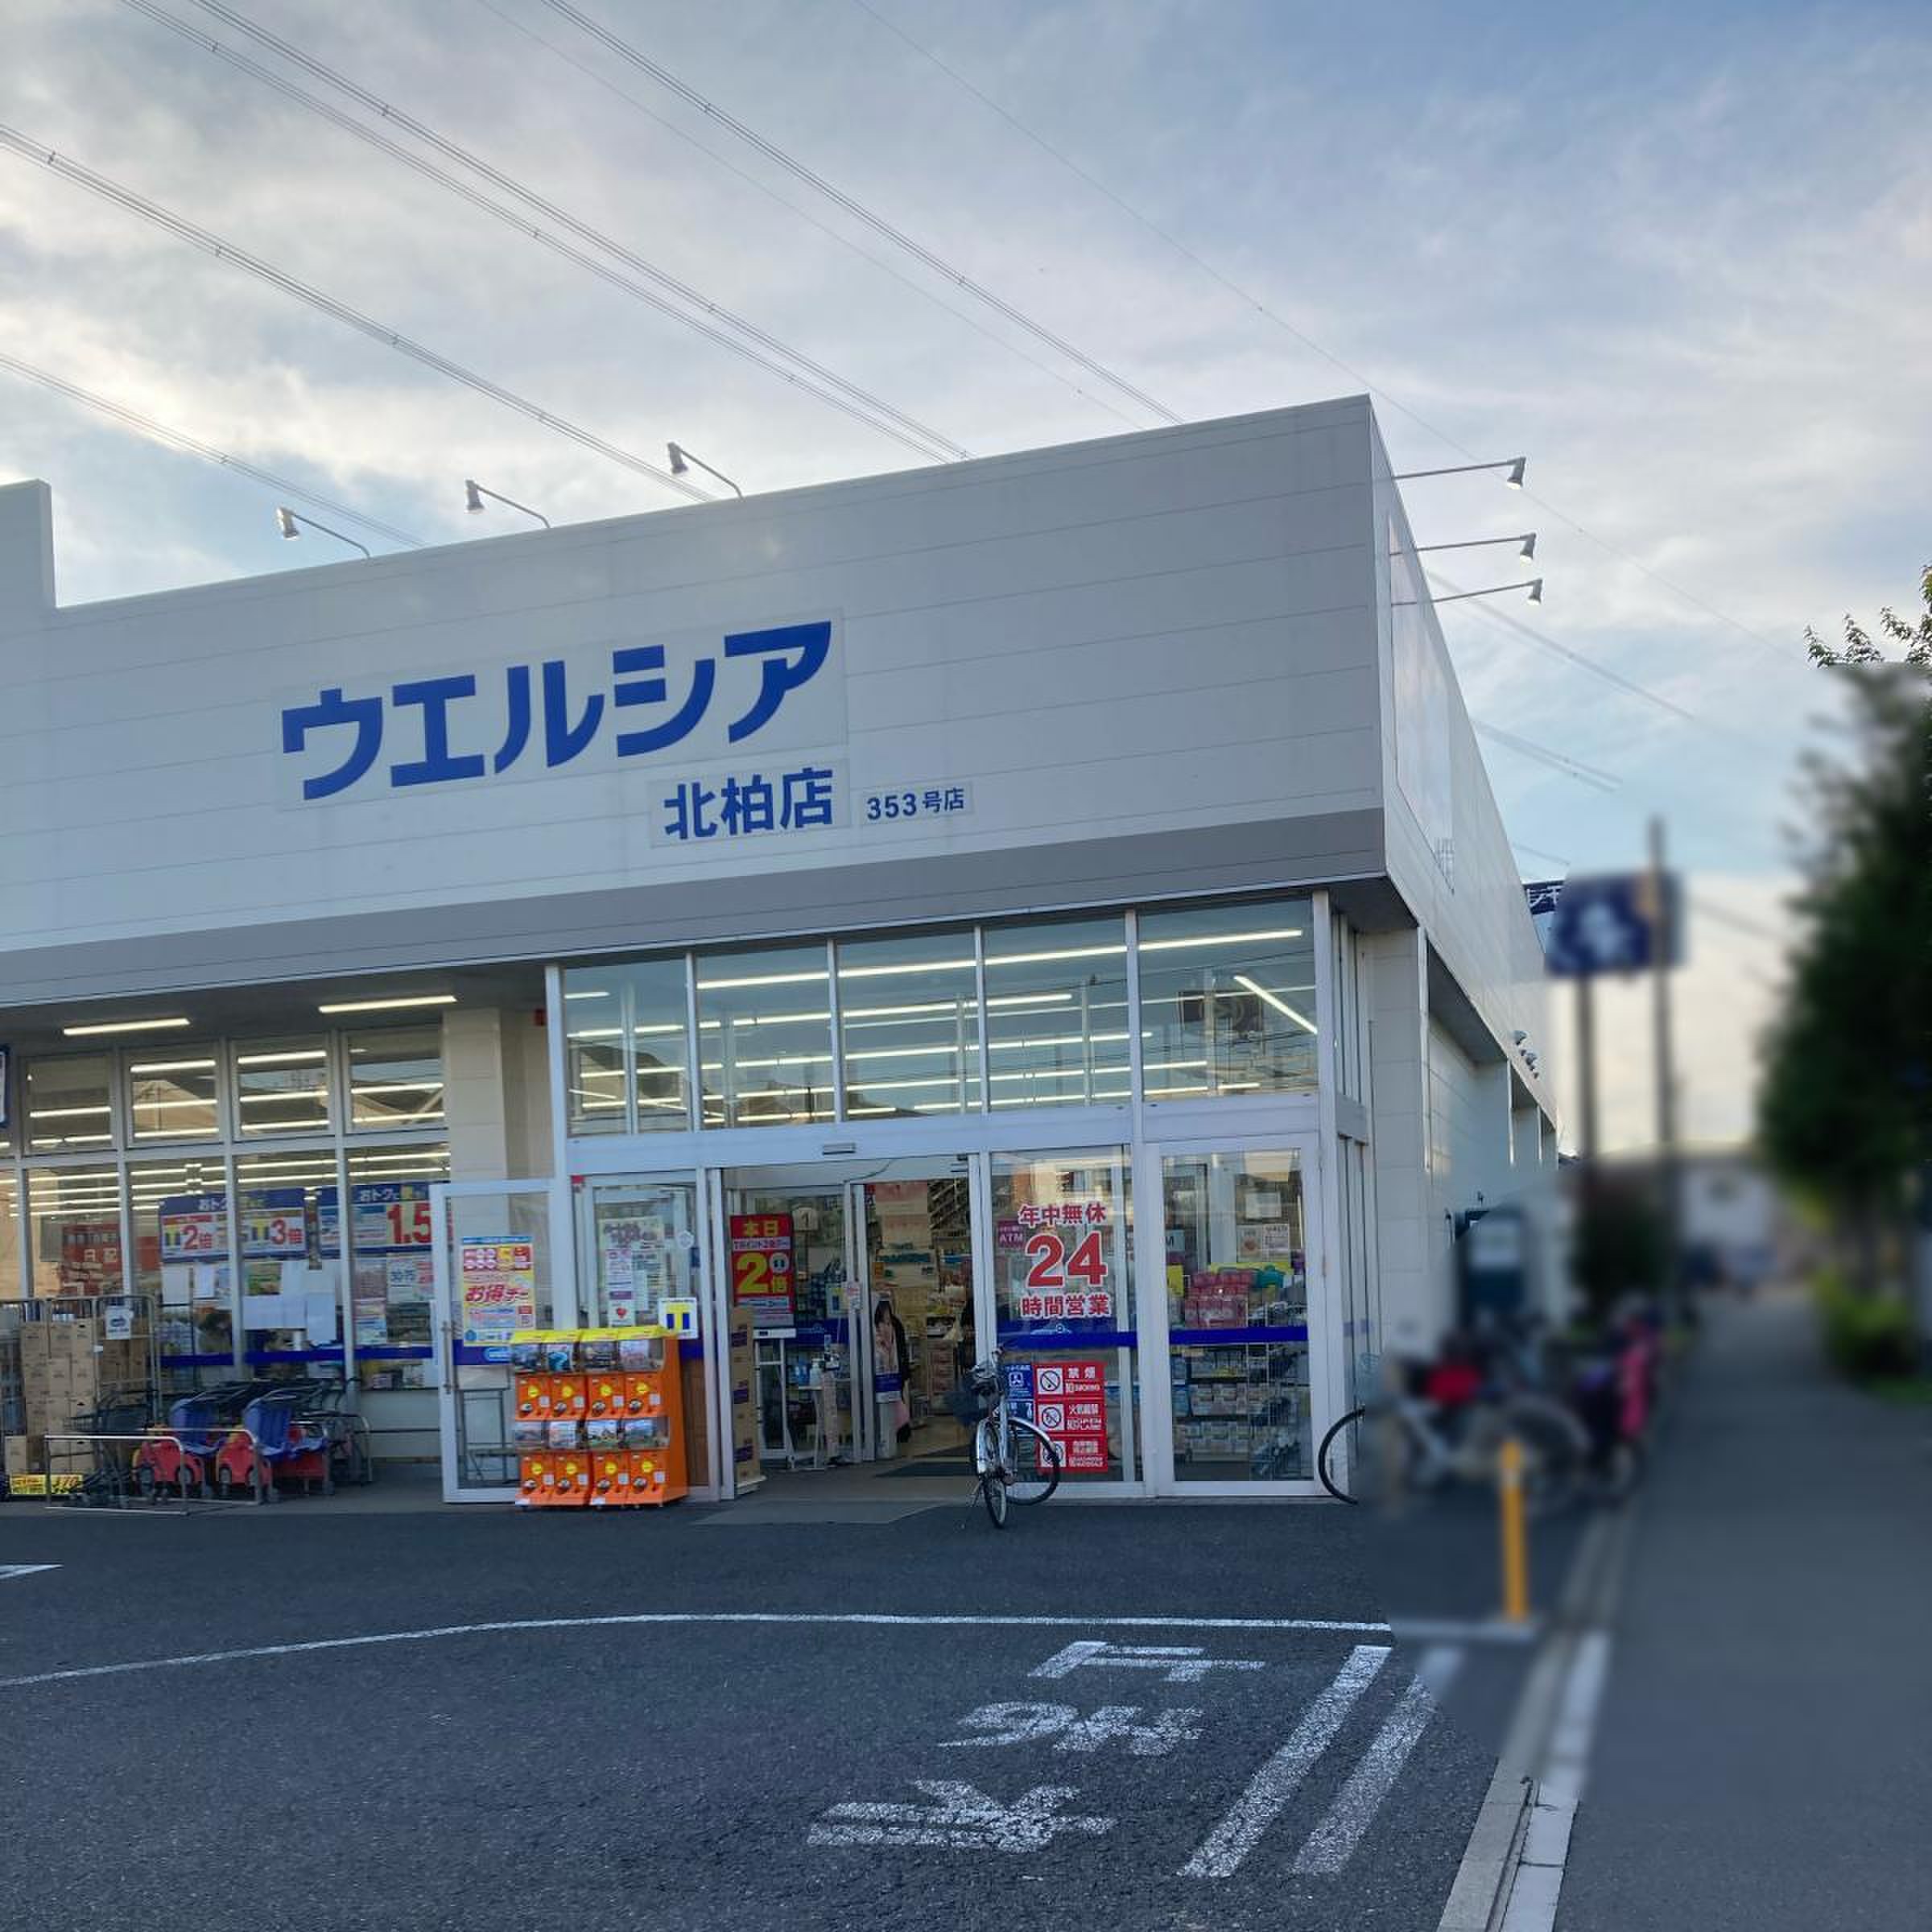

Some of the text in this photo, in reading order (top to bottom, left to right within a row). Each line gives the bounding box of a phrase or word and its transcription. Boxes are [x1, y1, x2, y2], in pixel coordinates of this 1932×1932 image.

[282, 621, 832, 800] ウエルシア
[664, 767, 833, 840] 北柏店
[866, 787, 965, 820] 353号店
[744, 1220, 778, 1236] 本日
[1019, 1203, 1106, 1226] 年中無休
[1000, 1235, 1024, 1244] ATM
[1026, 1232, 1108, 1287] 24
[1022, 1294, 1111, 1317] 時間営業
